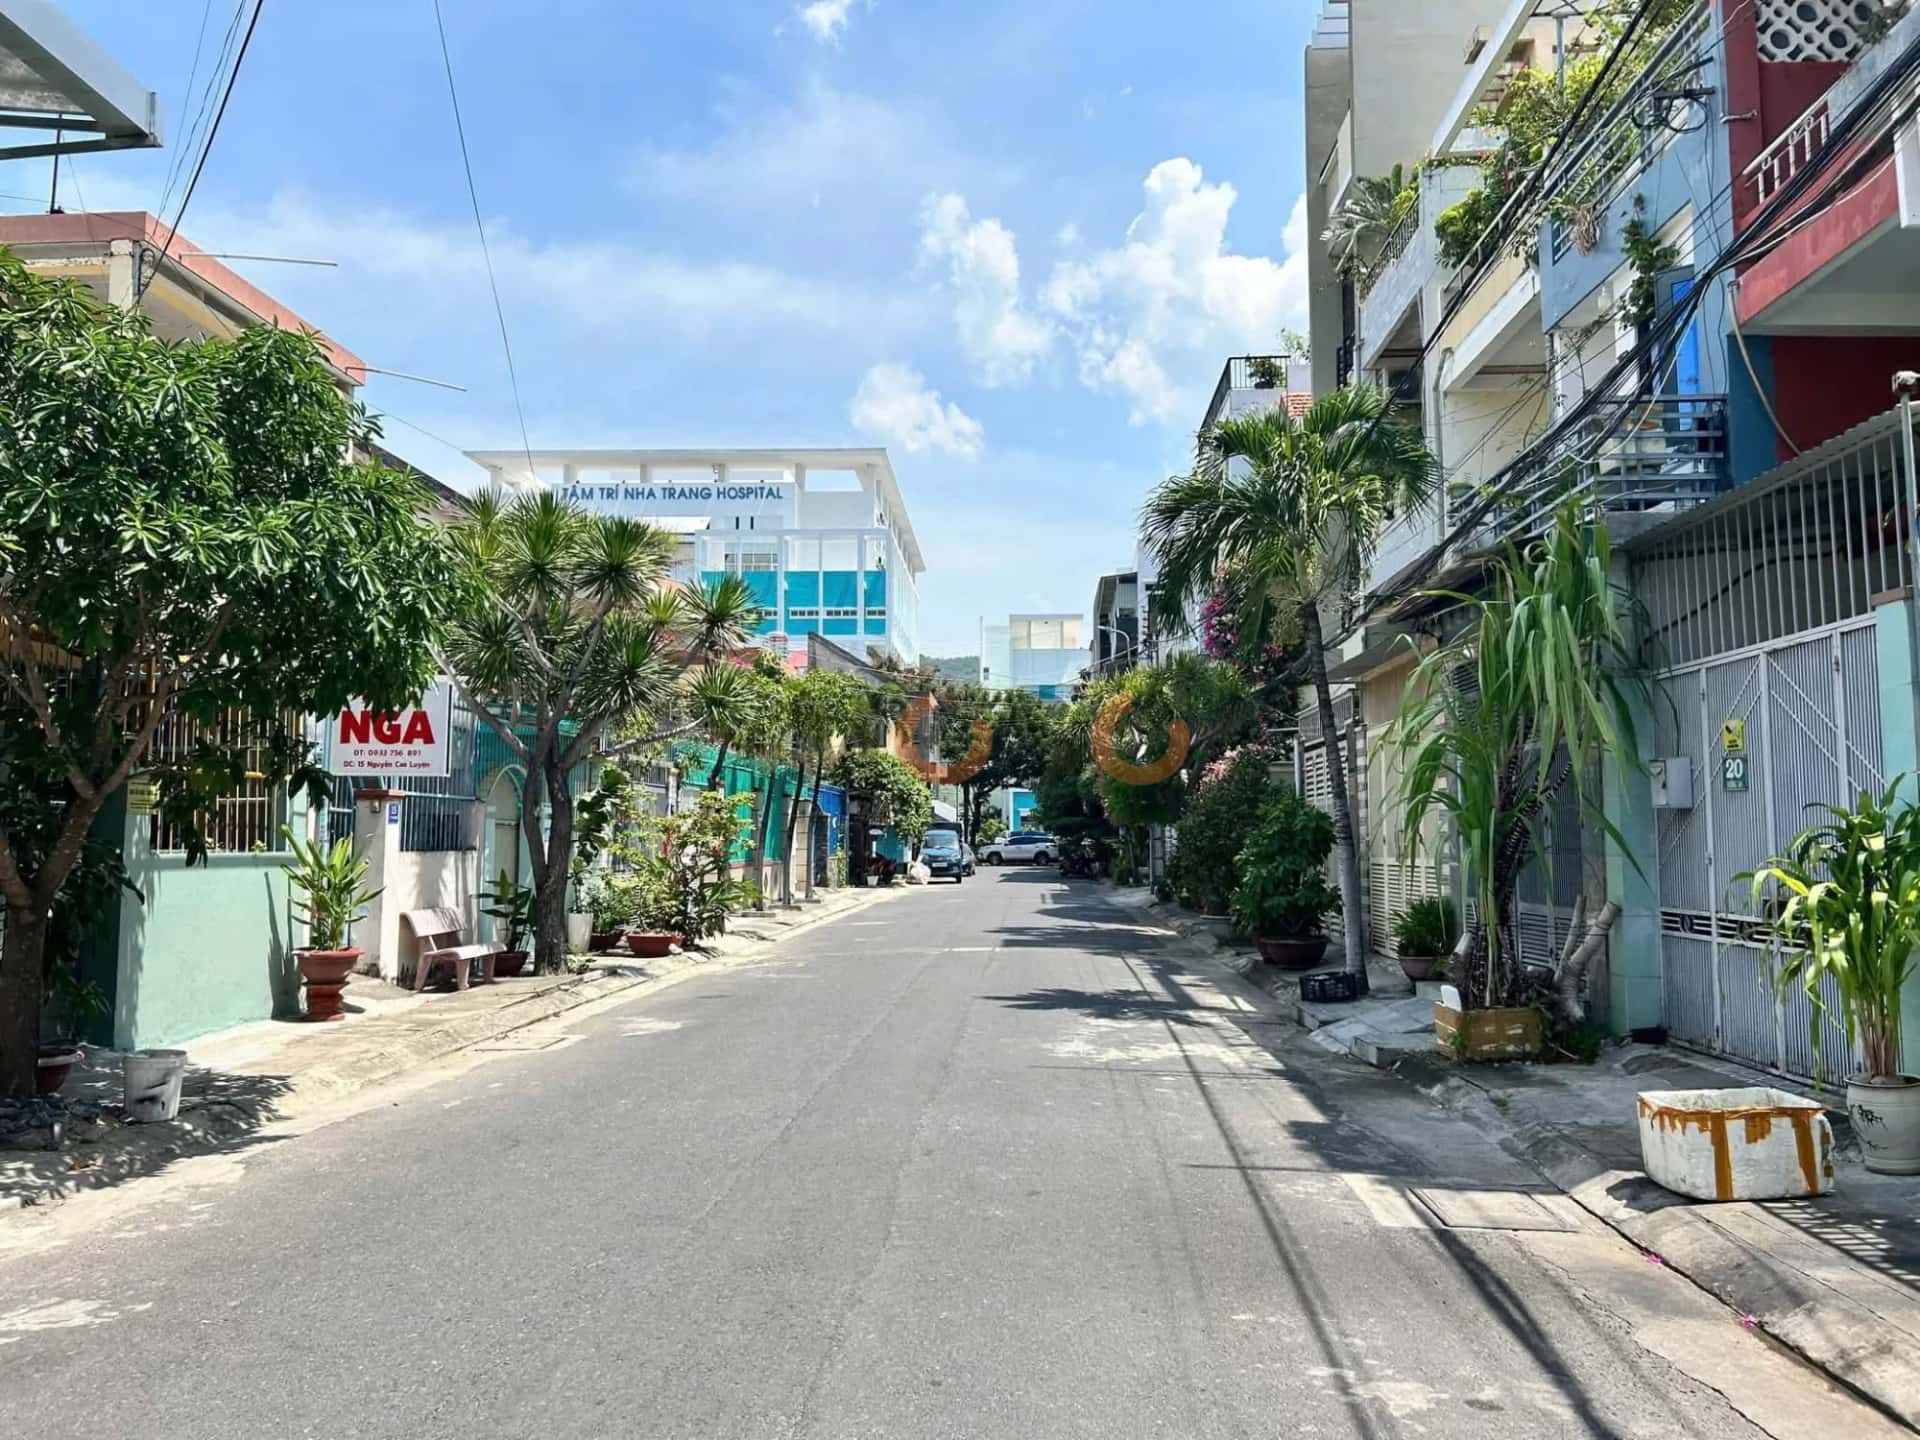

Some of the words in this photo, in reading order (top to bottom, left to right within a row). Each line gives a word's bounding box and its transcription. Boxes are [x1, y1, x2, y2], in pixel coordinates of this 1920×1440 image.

[562, 484, 594, 500] TÂM
[598, 484, 619, 500] TRÍ
[624, 487, 656, 500] NHA
[660, 487, 713, 500] TRANG
[716, 486, 783, 500] HOSPITAL
[340, 710, 435, 744] NGA
[1725, 759, 1743, 778] 20
